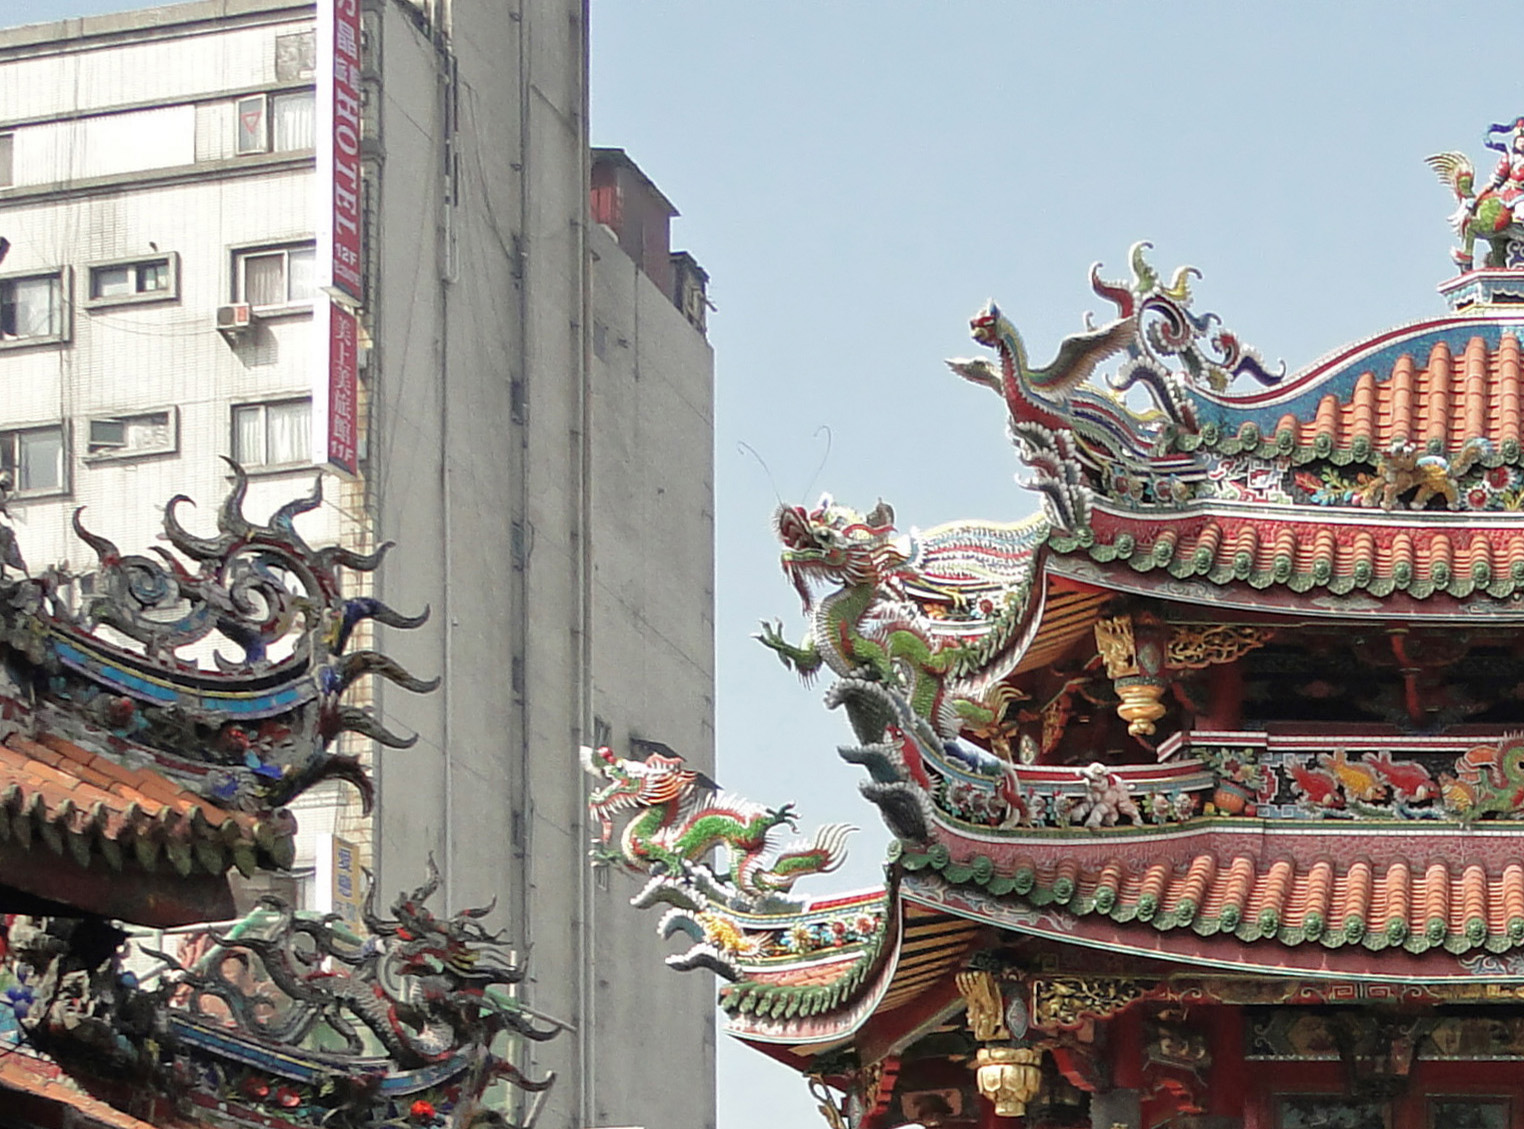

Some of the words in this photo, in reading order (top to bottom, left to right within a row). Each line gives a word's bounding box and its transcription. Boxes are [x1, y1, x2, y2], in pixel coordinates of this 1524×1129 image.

[335, 86, 358, 235] HOTEL
[334, 242, 358, 266] 12F
[331, 441, 354, 462] 11F
